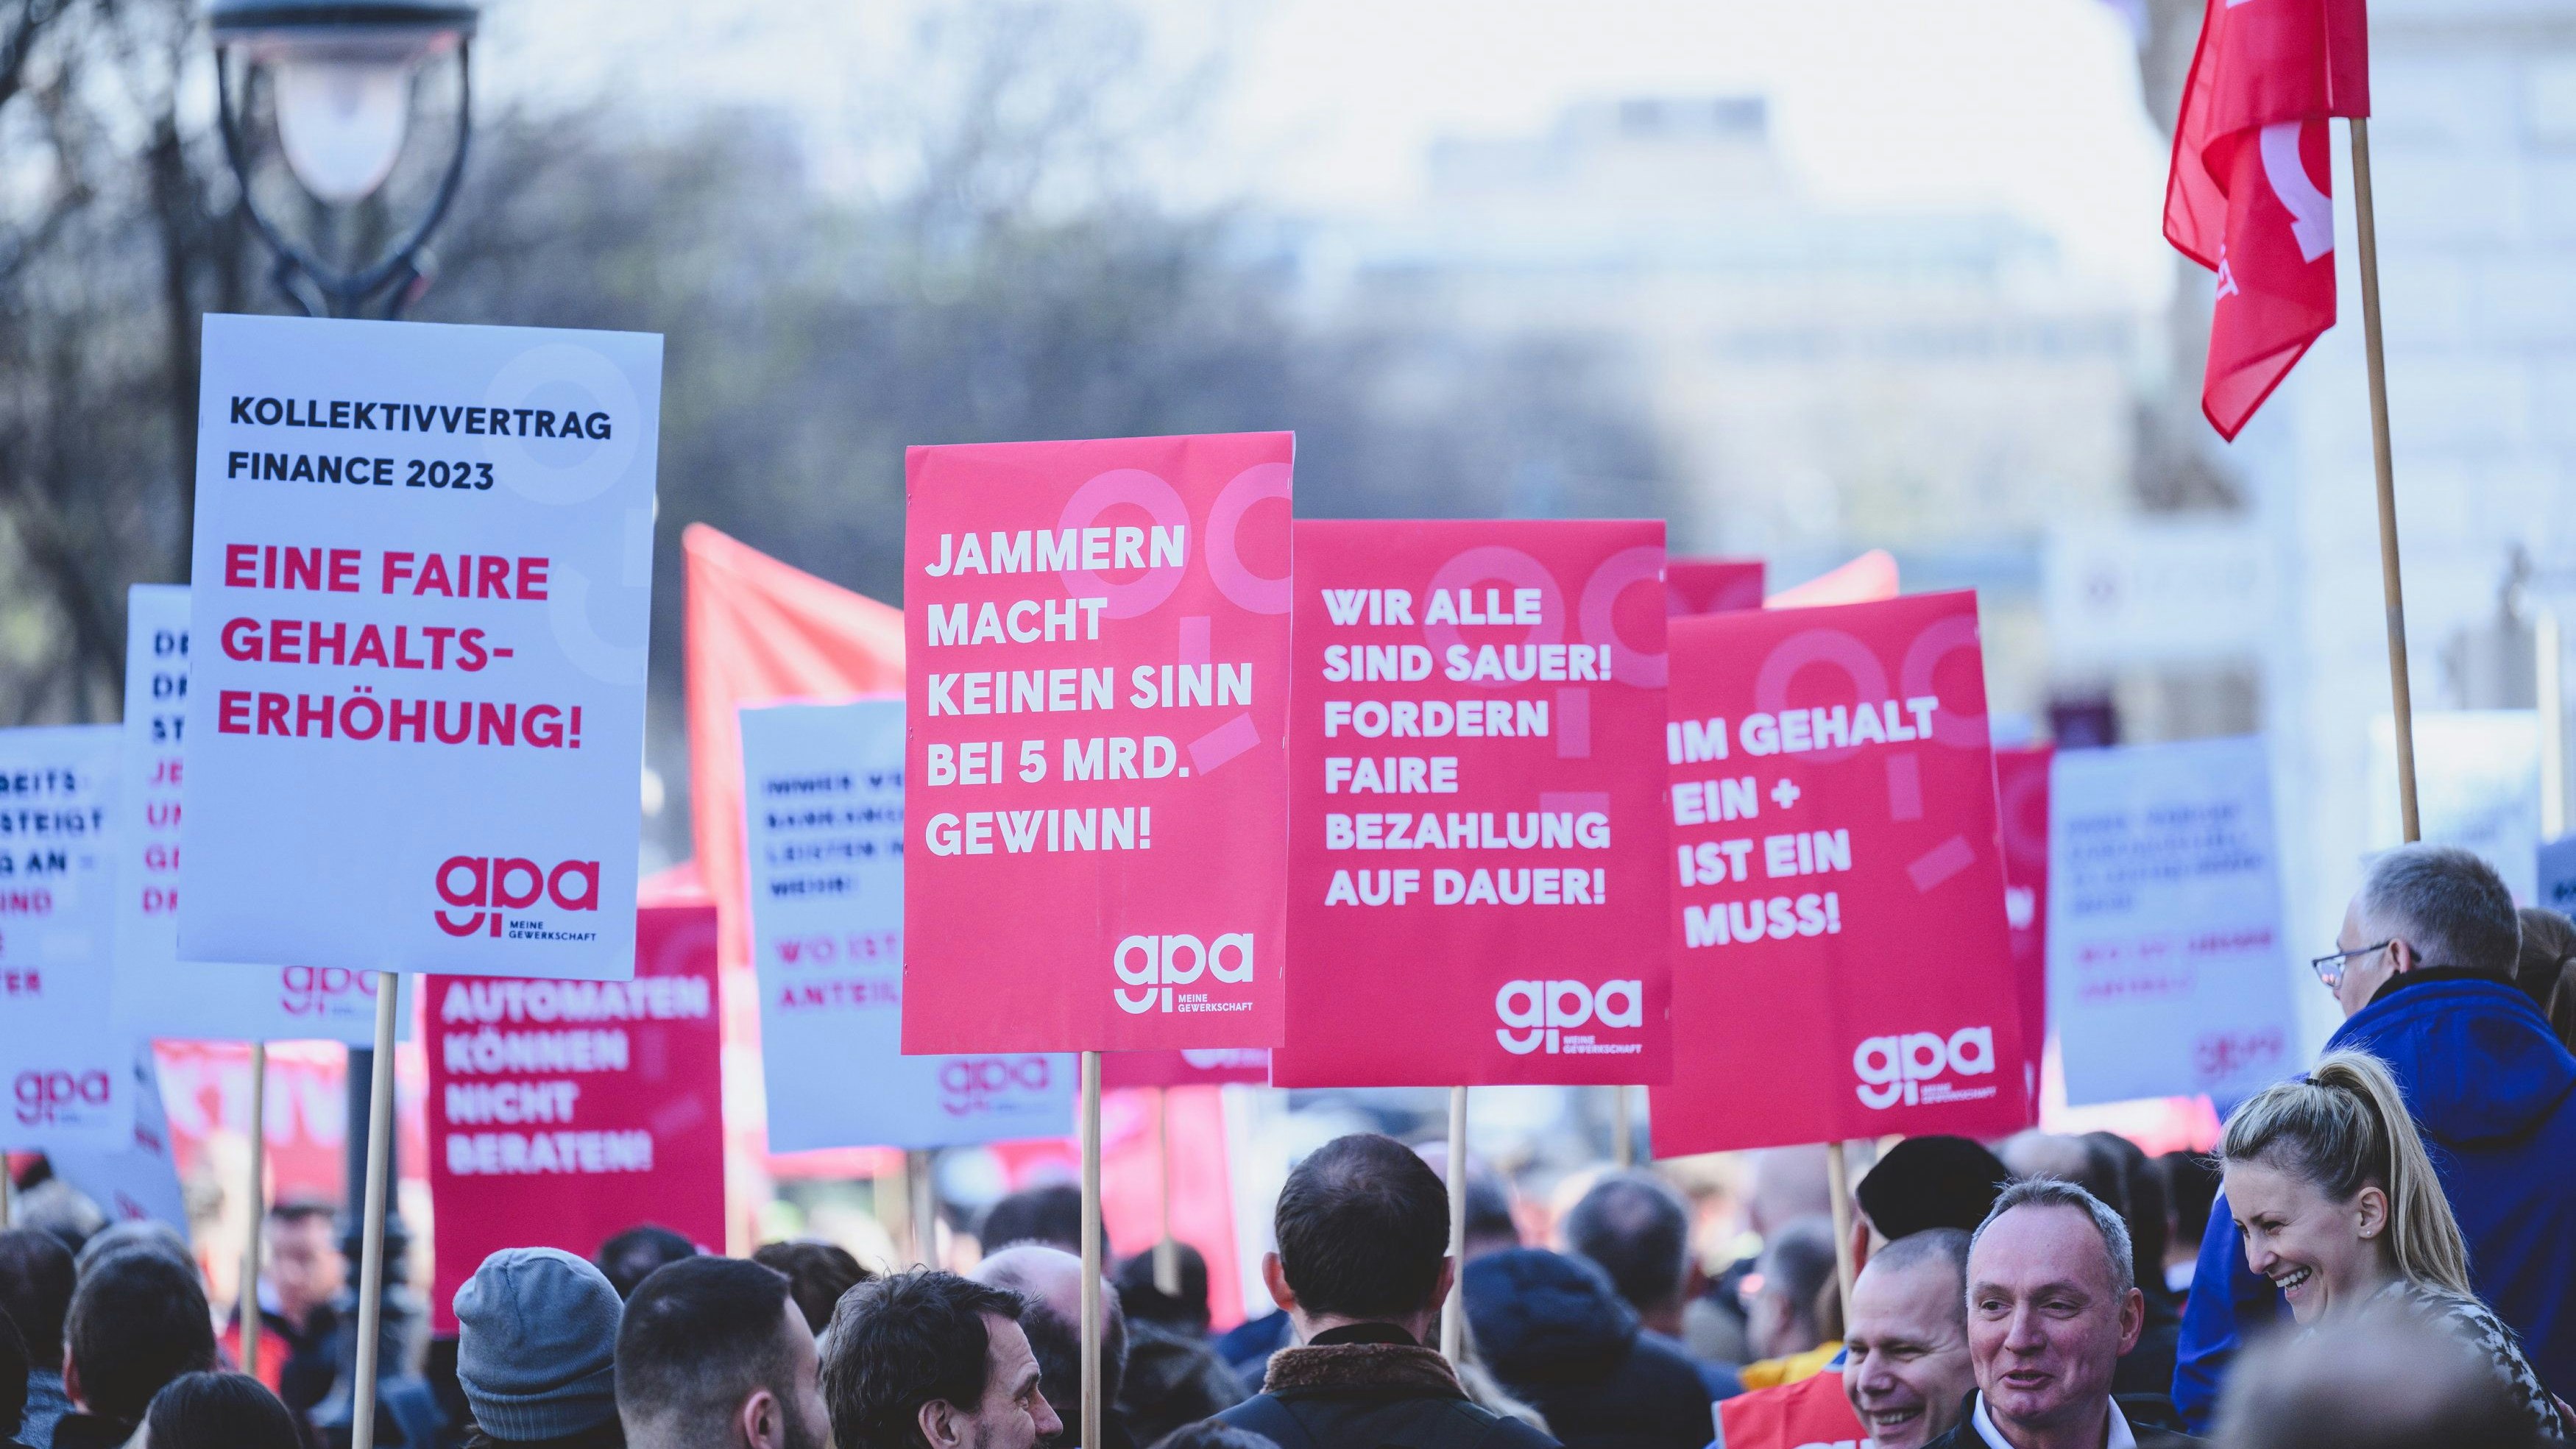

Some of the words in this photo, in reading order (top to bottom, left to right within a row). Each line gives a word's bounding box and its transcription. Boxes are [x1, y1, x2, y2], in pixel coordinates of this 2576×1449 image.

[230, 395, 612, 440] KOLLEKTIVVERTRAG
[227, 451, 394, 486] FINANCE
[406, 458, 495, 491] 2023
[224, 544, 361, 593] EINE
[381, 550, 550, 600] FAIRE
[924, 525, 1185, 577] JAMMERN
[927, 598, 1108, 646] MACHT
[1321, 588, 1414, 626] WIR
[1424, 588, 1542, 626] ALLE
[222, 617, 514, 673] GEHALTS-
[1322, 644, 1433, 682] SIND
[1444, 644, 1612, 681] SAUER!
[927, 667, 1114, 716] KEINEN
[1129, 663, 1252, 709] SINN
[217, 685, 582, 749] ERHÖHUNG!
[1324, 700, 1549, 738] FORDERN
[1666, 717, 1728, 765] IM
[1739, 695, 1939, 757] GEHALT
[927, 741, 1002, 786] BEI
[1019, 740, 1047, 784] 5
[1063, 736, 1189, 782] MRD.
[1325, 757, 1459, 793] FAIRE
[1671, 776, 1759, 826] EIN
[1771, 778, 1801, 809] +
[924, 807, 1151, 857] GEWINN!
[1326, 812, 1611, 850] BEZAHLUNG
[1677, 837, 1754, 888] IST
[1764, 828, 1852, 879] EIN
[434, 854, 601, 938] gpa
[1324, 869, 1420, 906] AUF
[1432, 868, 1606, 906] DAUER!
[509, 920, 544, 930] MEINE
[509, 929, 597, 943] GEWERKSCHAFT
[1683, 891, 1841, 948] MUSS!
[1113, 932, 1254, 1014] gpa
[443, 974, 710, 1024] AUTOMATEN
[1178, 993, 1208, 1003] MEINE
[1178, 1002, 1253, 1013] GEWERKSCHAFT
[1495, 979, 1643, 1055] gpa
[443, 1027, 630, 1074] KÖNNEN
[1563, 1035, 1596, 1045] MEINE
[1563, 1044, 1643, 1054] GEWERKSCHAFT
[1853, 1026, 1995, 1110] gpa
[445, 1080, 579, 1124] NICHT
[1921, 1086, 1997, 1105] GEWERKSCHAFT
[446, 1130, 654, 1176] BERATEN!
